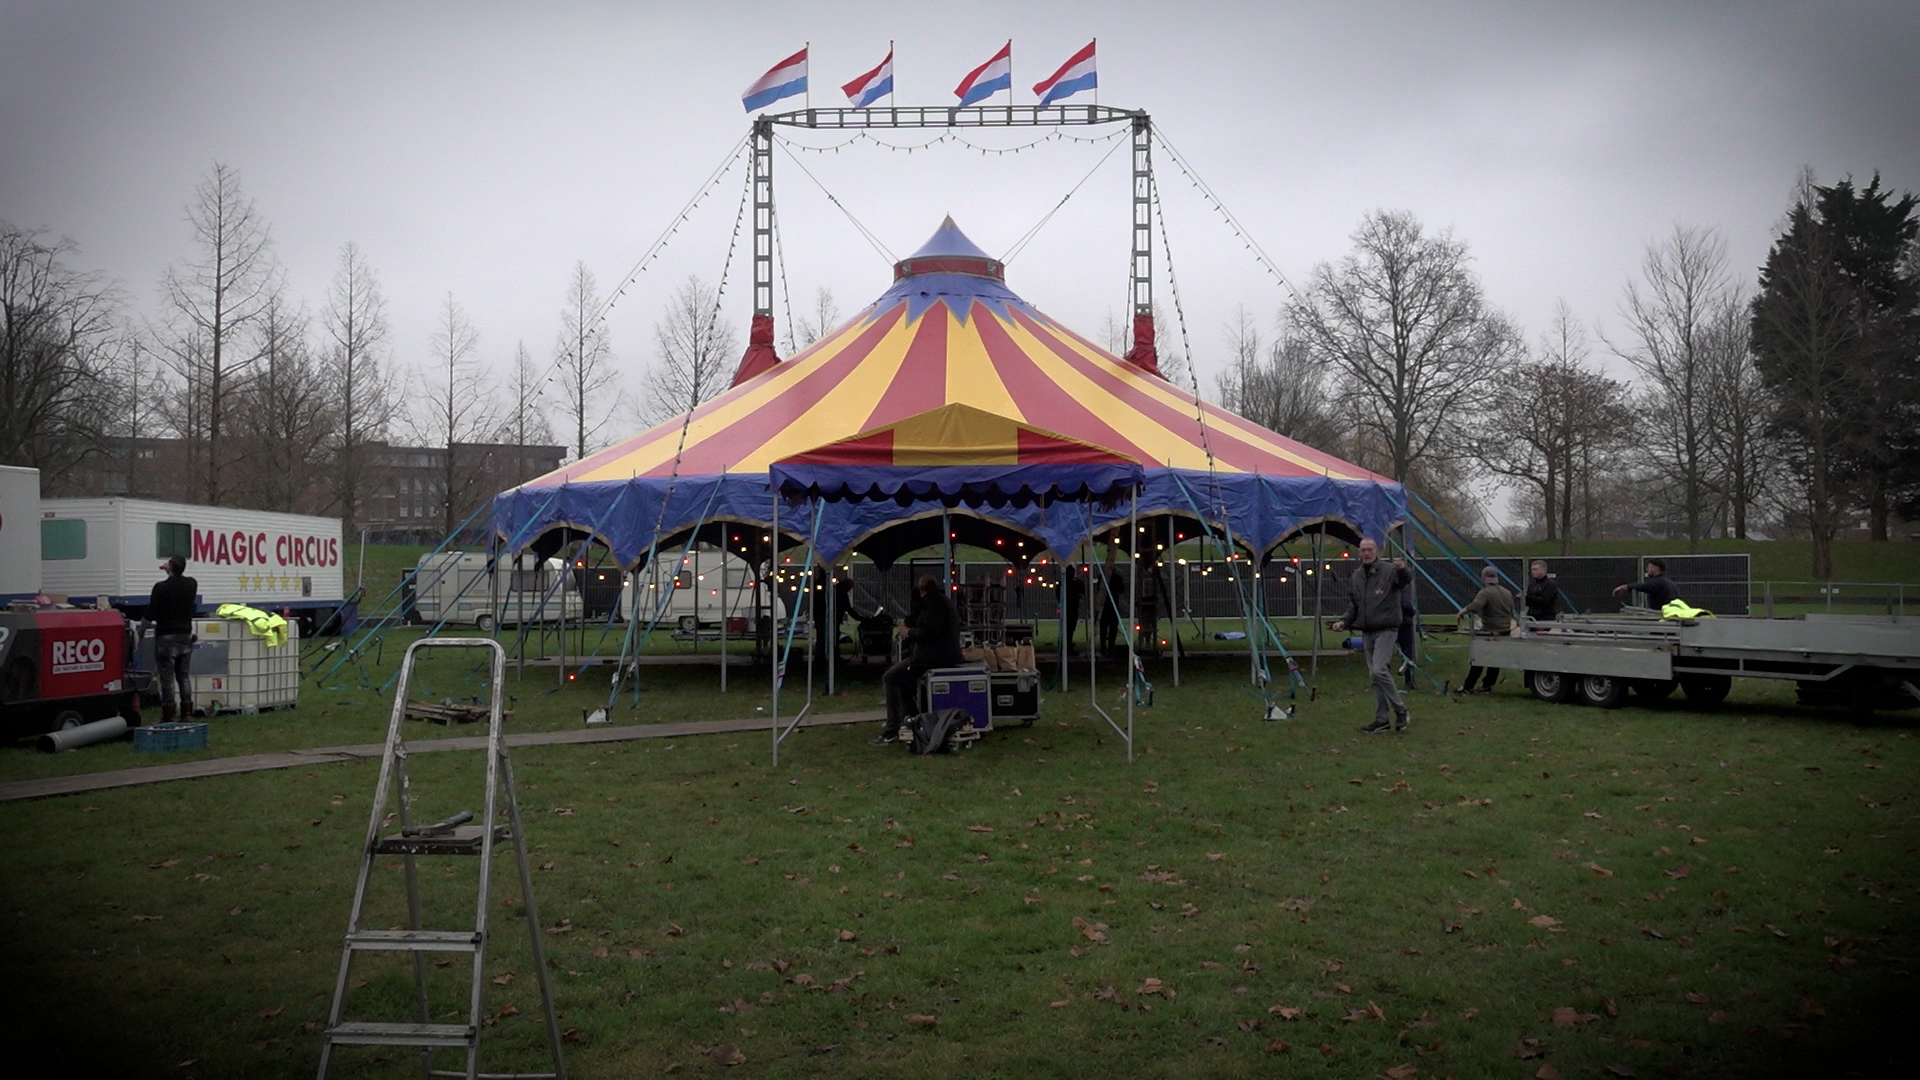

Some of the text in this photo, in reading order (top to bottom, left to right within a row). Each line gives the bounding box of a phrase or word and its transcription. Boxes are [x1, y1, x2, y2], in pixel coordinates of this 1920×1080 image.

[193, 529, 338, 568] MAGIC CIRCUS
[52, 638, 105, 665] RECO
